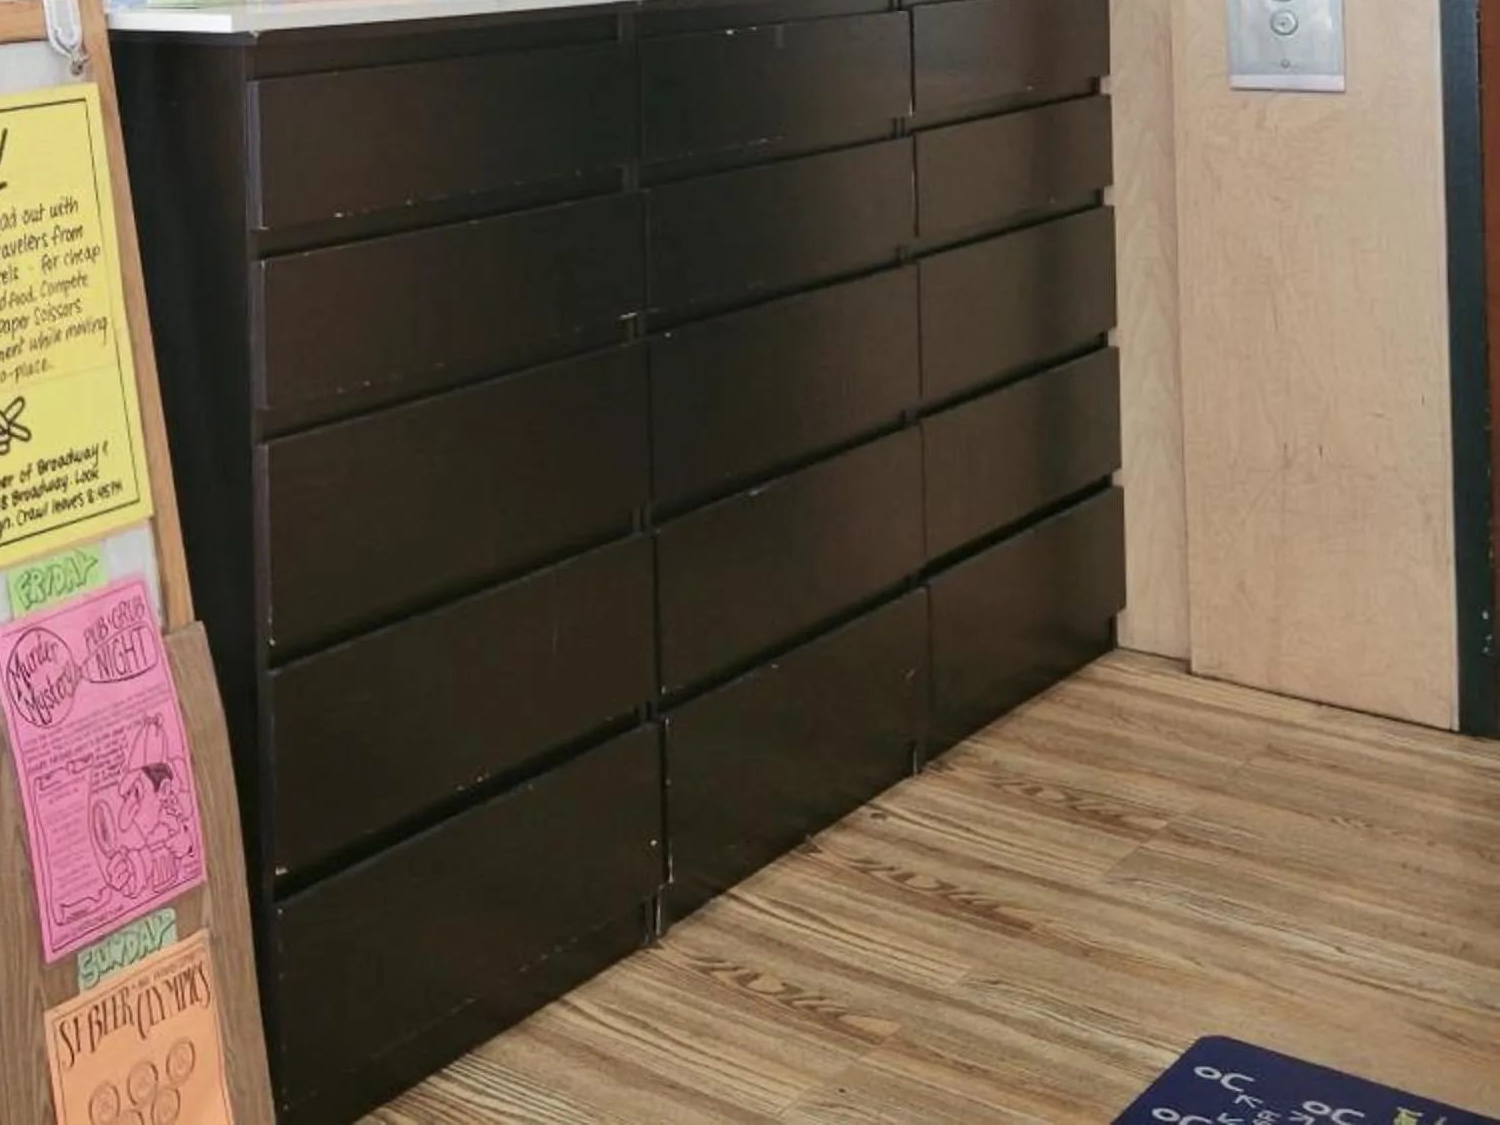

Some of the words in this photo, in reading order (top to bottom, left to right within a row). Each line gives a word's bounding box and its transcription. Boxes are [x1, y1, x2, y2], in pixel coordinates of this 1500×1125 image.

[21, 203, 46, 224] out
[50, 196, 79, 219] with
[51, 224, 84, 247] from
[62, 244, 102, 266] cheap
[40, 273, 89, 298] Compete
[65, 315, 109, 349] moving
[19, 462, 34, 484] of
[36, 442, 101, 477] Broadway
[15, 501, 50, 527] Crawl
[50, 491, 86, 515] leaves
[15, 549, 99, 611] FRIDAY
[94, 625, 151, 681] NIGHT
[87, 985, 135, 1054] BEER
[136, 958, 212, 1041] OLYMPICS
